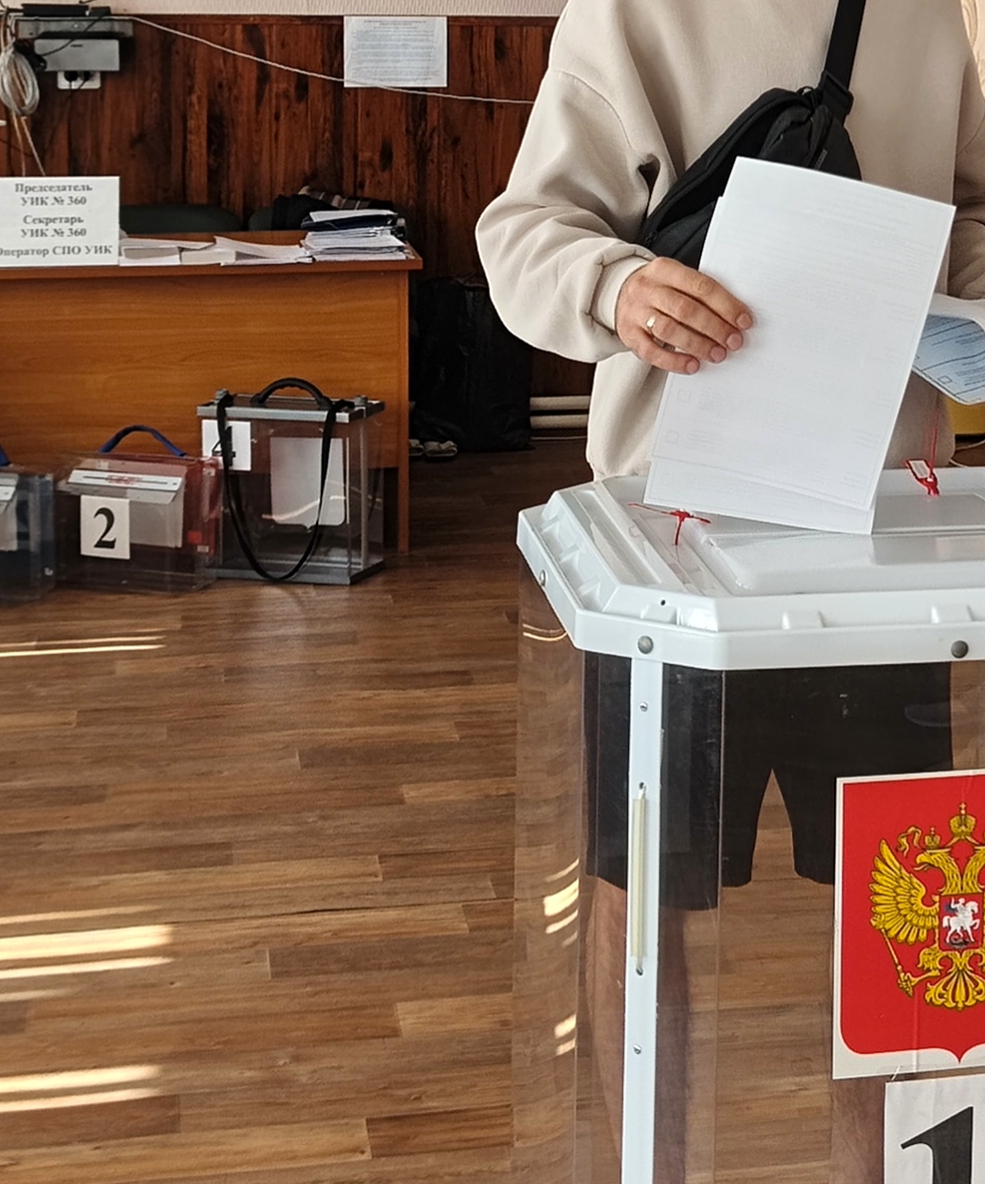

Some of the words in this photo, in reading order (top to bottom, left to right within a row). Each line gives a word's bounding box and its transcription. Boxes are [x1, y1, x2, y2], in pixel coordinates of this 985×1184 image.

[15, 183, 93, 195] Председатель
[20, 196, 49, 206] УИК
[51, 196, 64, 205] №
[67, 196, 87, 205] 360
[23, 215, 84, 226] Секретарь
[20, 228, 49, 238] УИК
[51, 228, 64, 237] №
[67, 228, 87, 237] 360
[52, 246, 81, 255] СПО
[84, 245, 113, 255] УИК
[93, 507, 117, 549] 2
